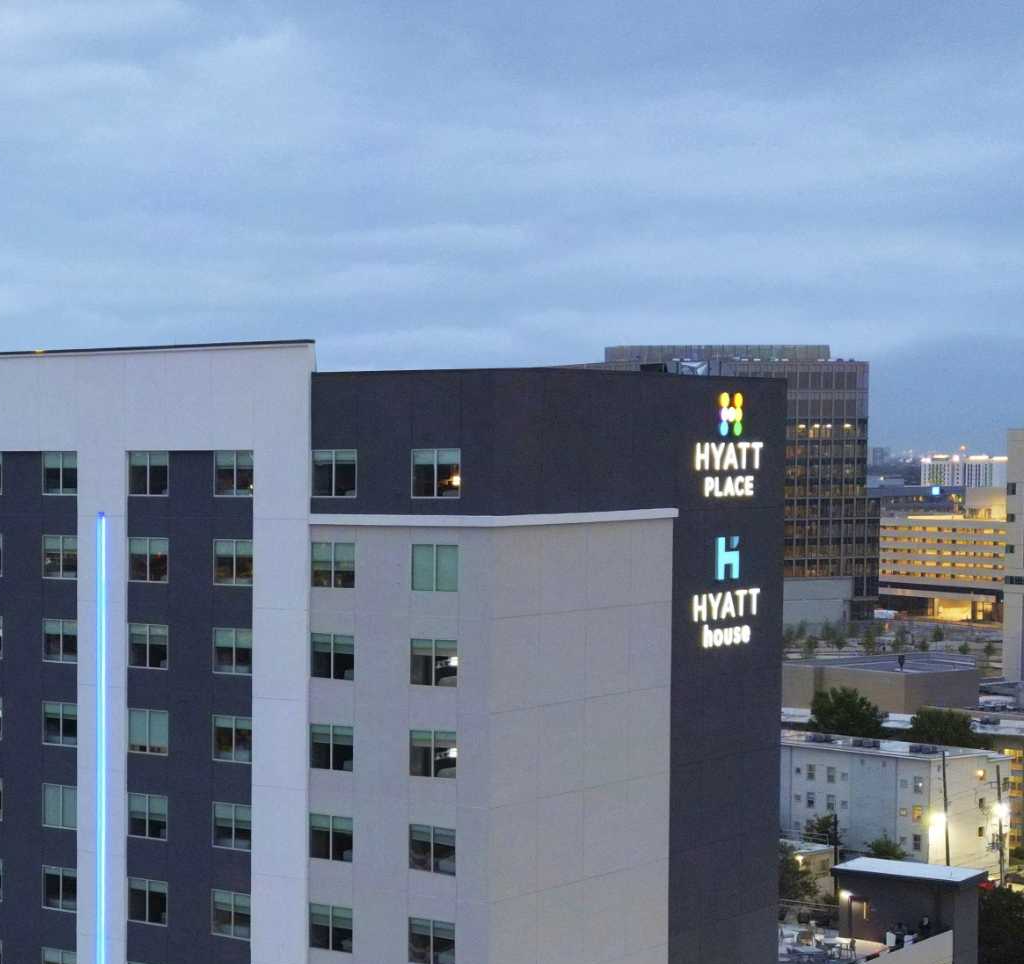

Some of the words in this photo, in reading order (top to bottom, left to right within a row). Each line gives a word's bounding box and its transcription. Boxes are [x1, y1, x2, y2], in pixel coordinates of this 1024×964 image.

[694, 441, 764, 471] HYATT
[703, 475, 755, 498] PLACE
[692, 587, 761, 623] HYATT
[701, 624, 752, 649] house
